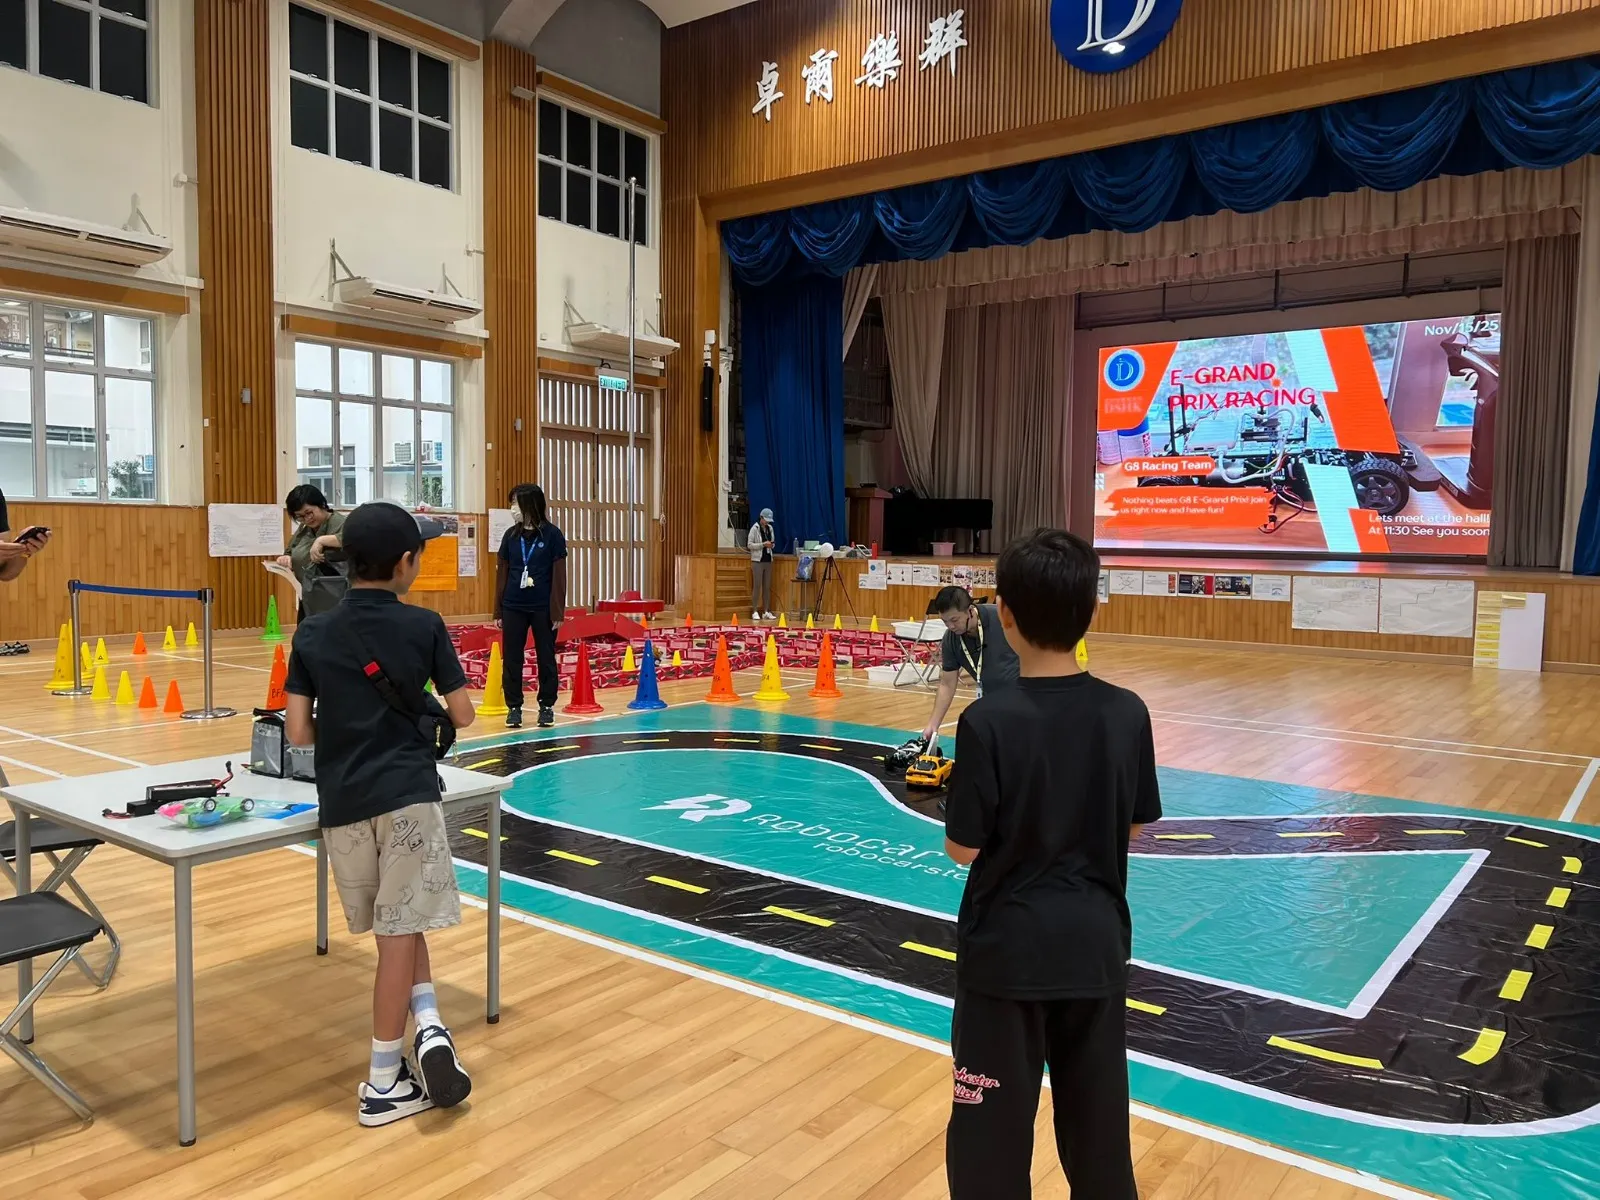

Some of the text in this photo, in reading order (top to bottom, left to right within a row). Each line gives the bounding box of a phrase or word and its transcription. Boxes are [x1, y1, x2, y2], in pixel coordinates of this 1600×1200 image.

[1425, 320, 1499, 336] Nov/15/25
[1170, 363, 1276, 386] E-GRAND
[1170, 387, 1316, 412] PRIX RACING
[1124, 460, 1212, 472] G8 Racing Team
[1122, 497, 1154, 505] Nothing
[1131, 506, 1150, 514] right
[1369, 514, 1393, 523] Lets
[1395, 514, 1425, 523] meet
[1427, 514, 1440, 523] at
[1443, 513, 1463, 523] the
[1368, 526, 1381, 535] At
[1384, 526, 1410, 535] 11:30
[1412, 526, 1434, 535] See
[1436, 527, 1460, 537] you
[742, 813, 972, 871] Robocar
